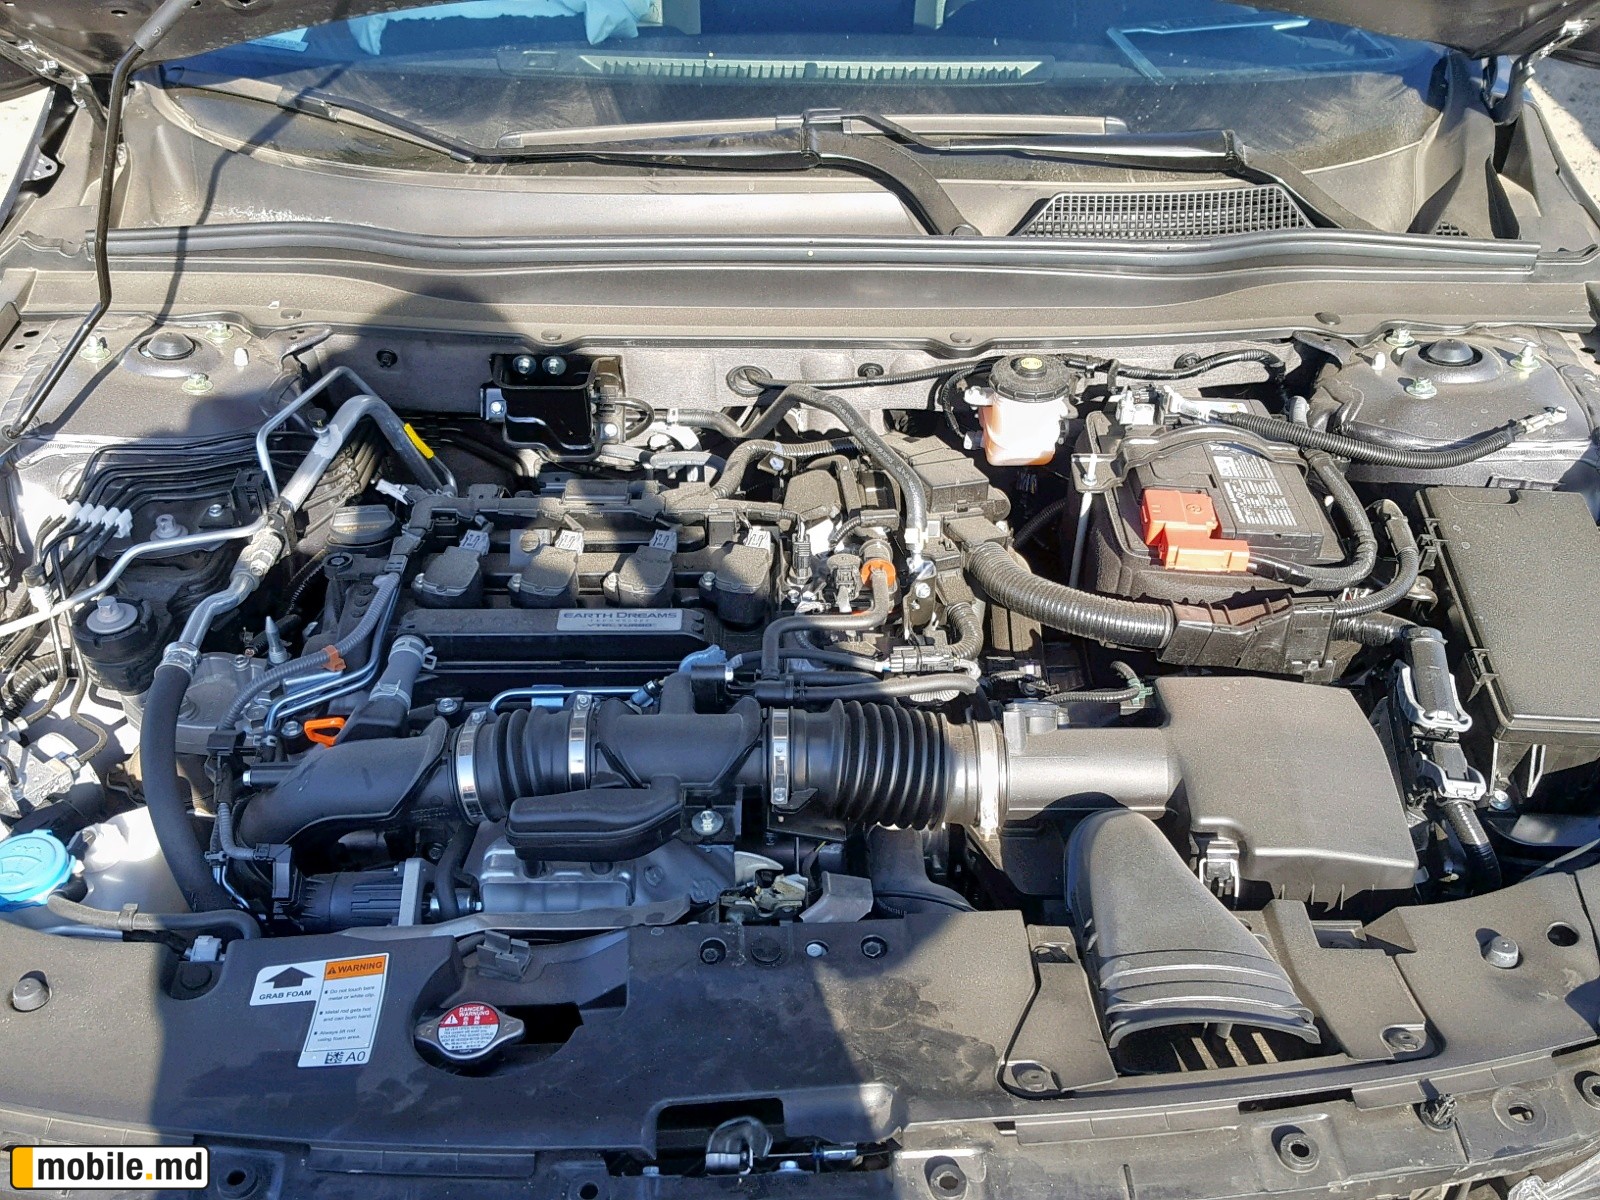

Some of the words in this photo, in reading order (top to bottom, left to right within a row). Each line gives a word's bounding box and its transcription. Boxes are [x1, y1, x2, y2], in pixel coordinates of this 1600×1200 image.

[616, 611, 678, 619] DREAMS
[337, 961, 383, 974] WARNING
[259, 991, 285, 1000] GRAB
[285, 989, 312, 998] FOAM
[344, 1051, 366, 1063] A0
